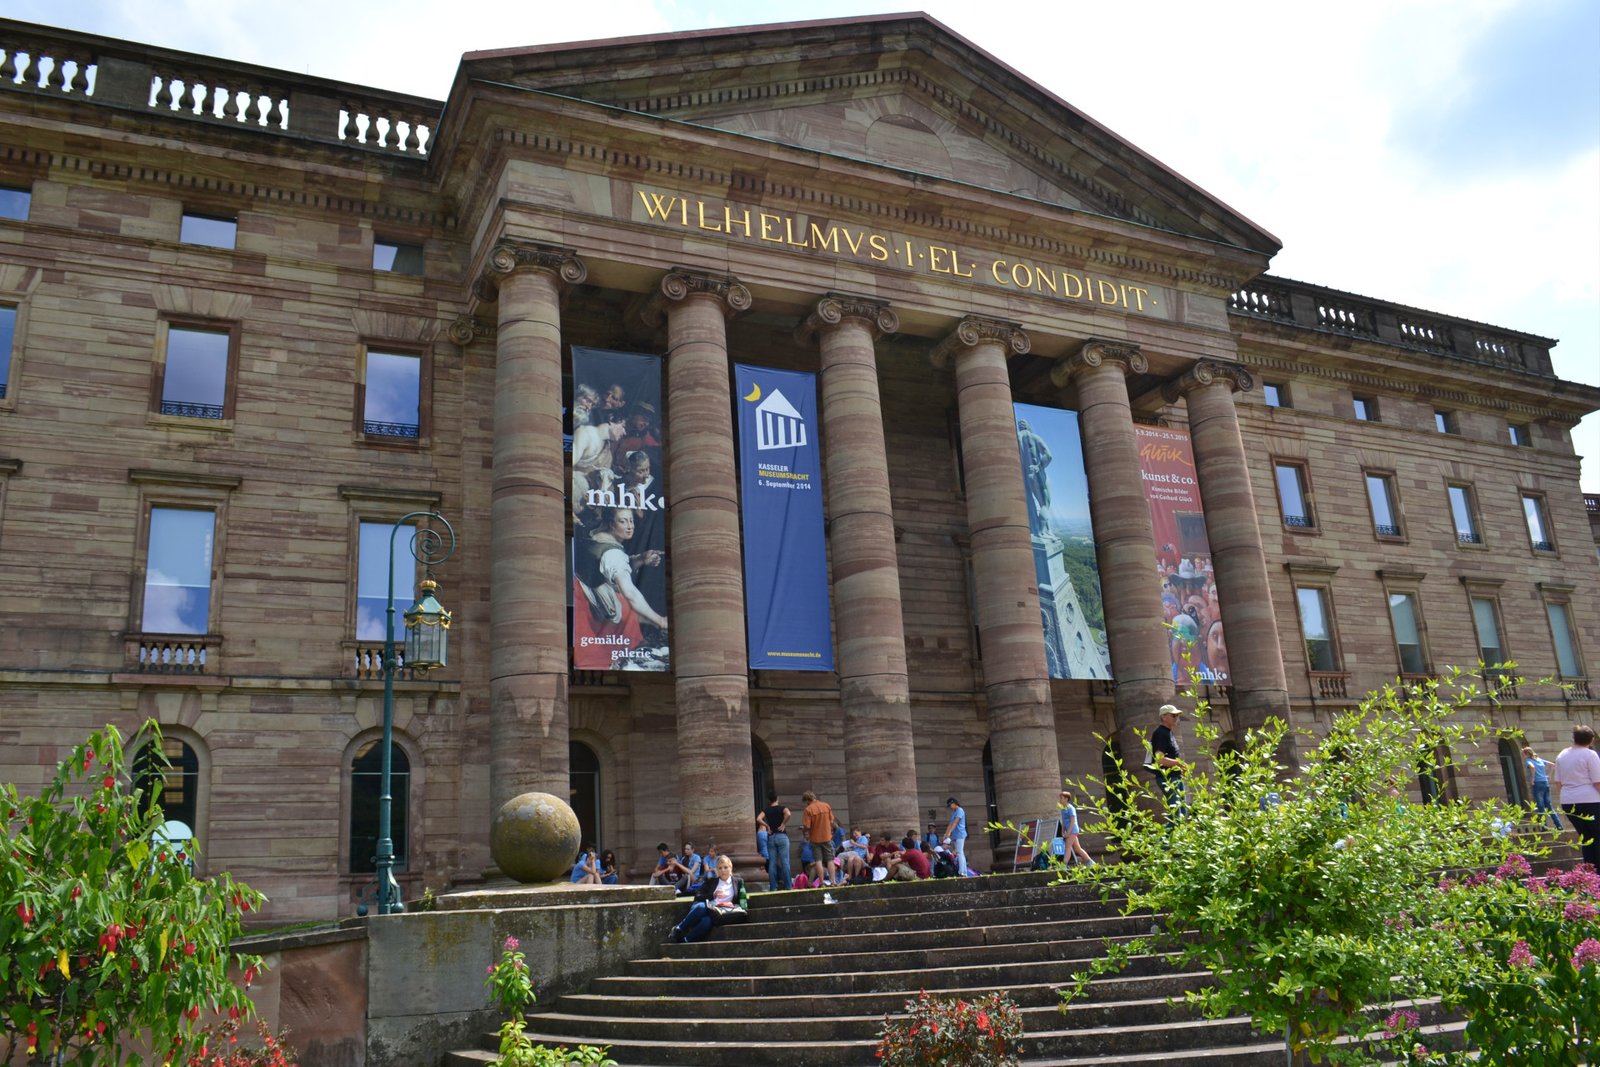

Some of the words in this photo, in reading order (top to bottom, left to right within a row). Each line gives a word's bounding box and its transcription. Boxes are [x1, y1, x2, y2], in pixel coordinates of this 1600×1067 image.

[992, 260, 1148, 311] CONDIDIT
[758, 463, 788, 472] KASSELER
[1141, 469, 1170, 483] kunst
[1171, 474, 1180, 484] &
[1181, 476, 1196, 485] co.
[765, 480, 795, 489] September
[580, 635, 630, 647] gemälde
[611, 648, 651, 661] galerie
